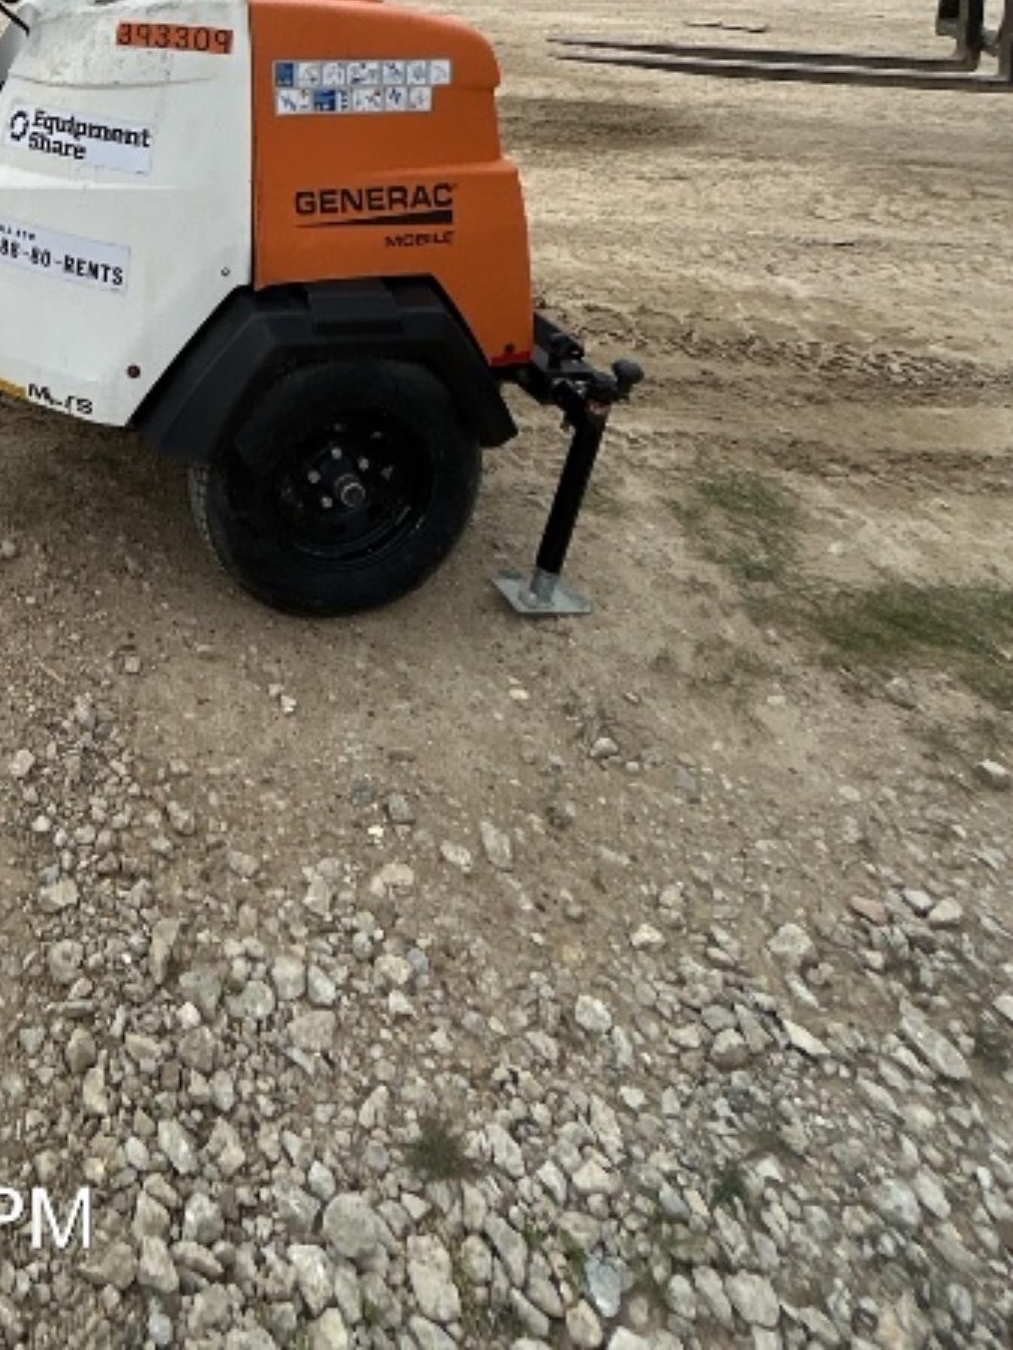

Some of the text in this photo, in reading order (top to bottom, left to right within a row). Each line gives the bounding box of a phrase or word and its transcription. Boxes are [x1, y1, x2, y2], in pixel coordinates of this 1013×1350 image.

[117, 22, 232, 53] 393309
[31, 108, 151, 148] Equipment
[28, 132, 87, 159] Share
[294, 182, 454, 216] GENERAC
[384, 230, 455, 248] MOBILE
